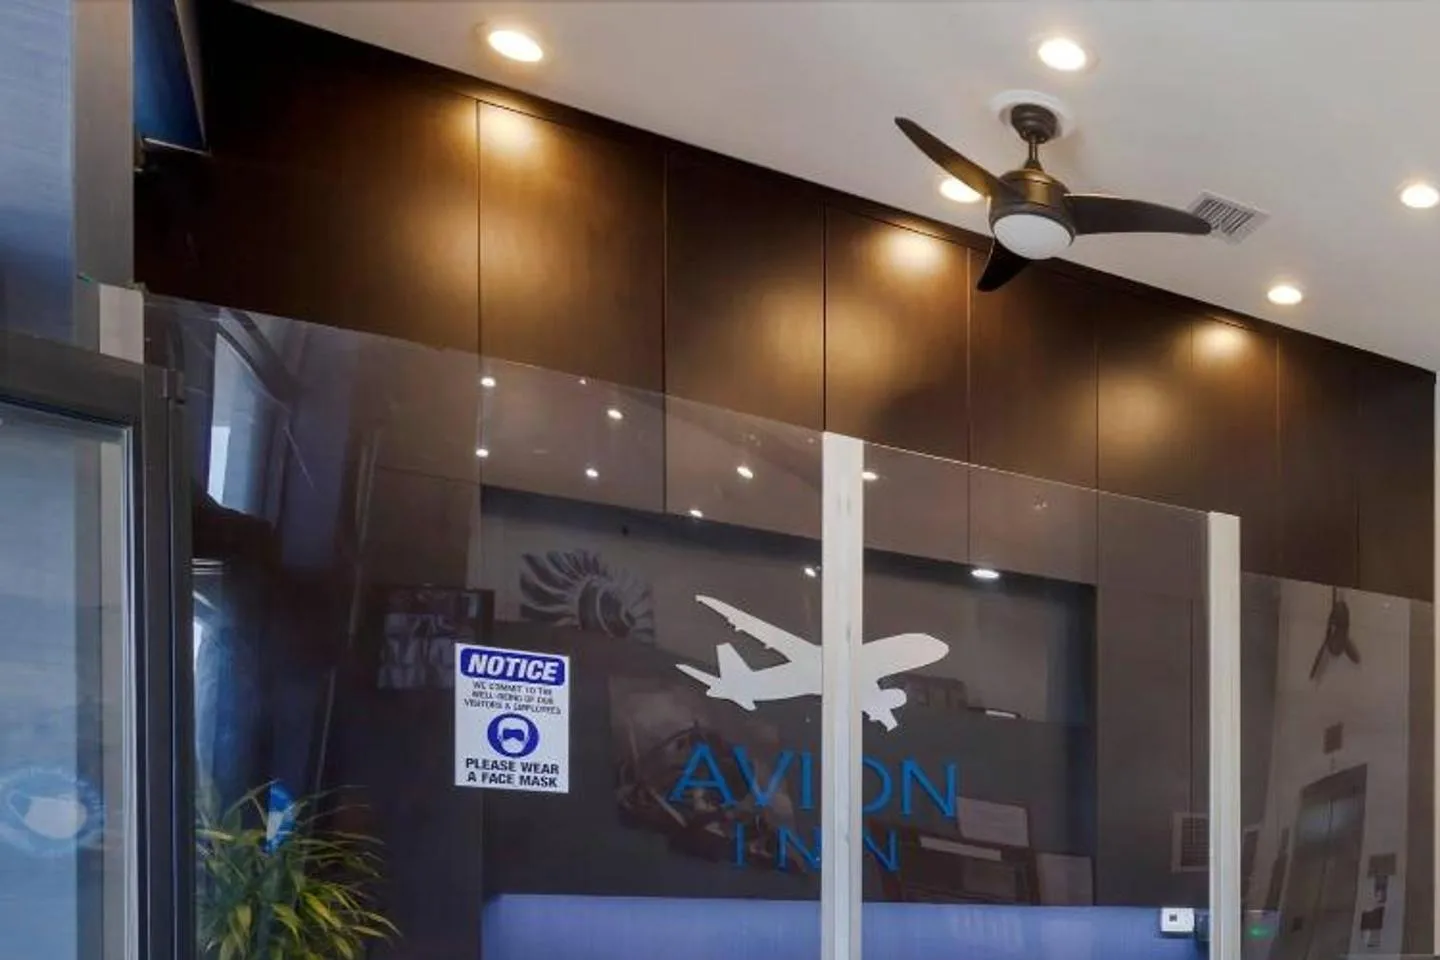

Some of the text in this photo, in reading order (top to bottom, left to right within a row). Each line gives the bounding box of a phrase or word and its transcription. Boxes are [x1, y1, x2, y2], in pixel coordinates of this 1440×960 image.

[467, 653, 559, 682] NOTICE
[465, 757, 560, 775] PLEASE WEAR
[467, 771, 559, 788] A FACE MASK
